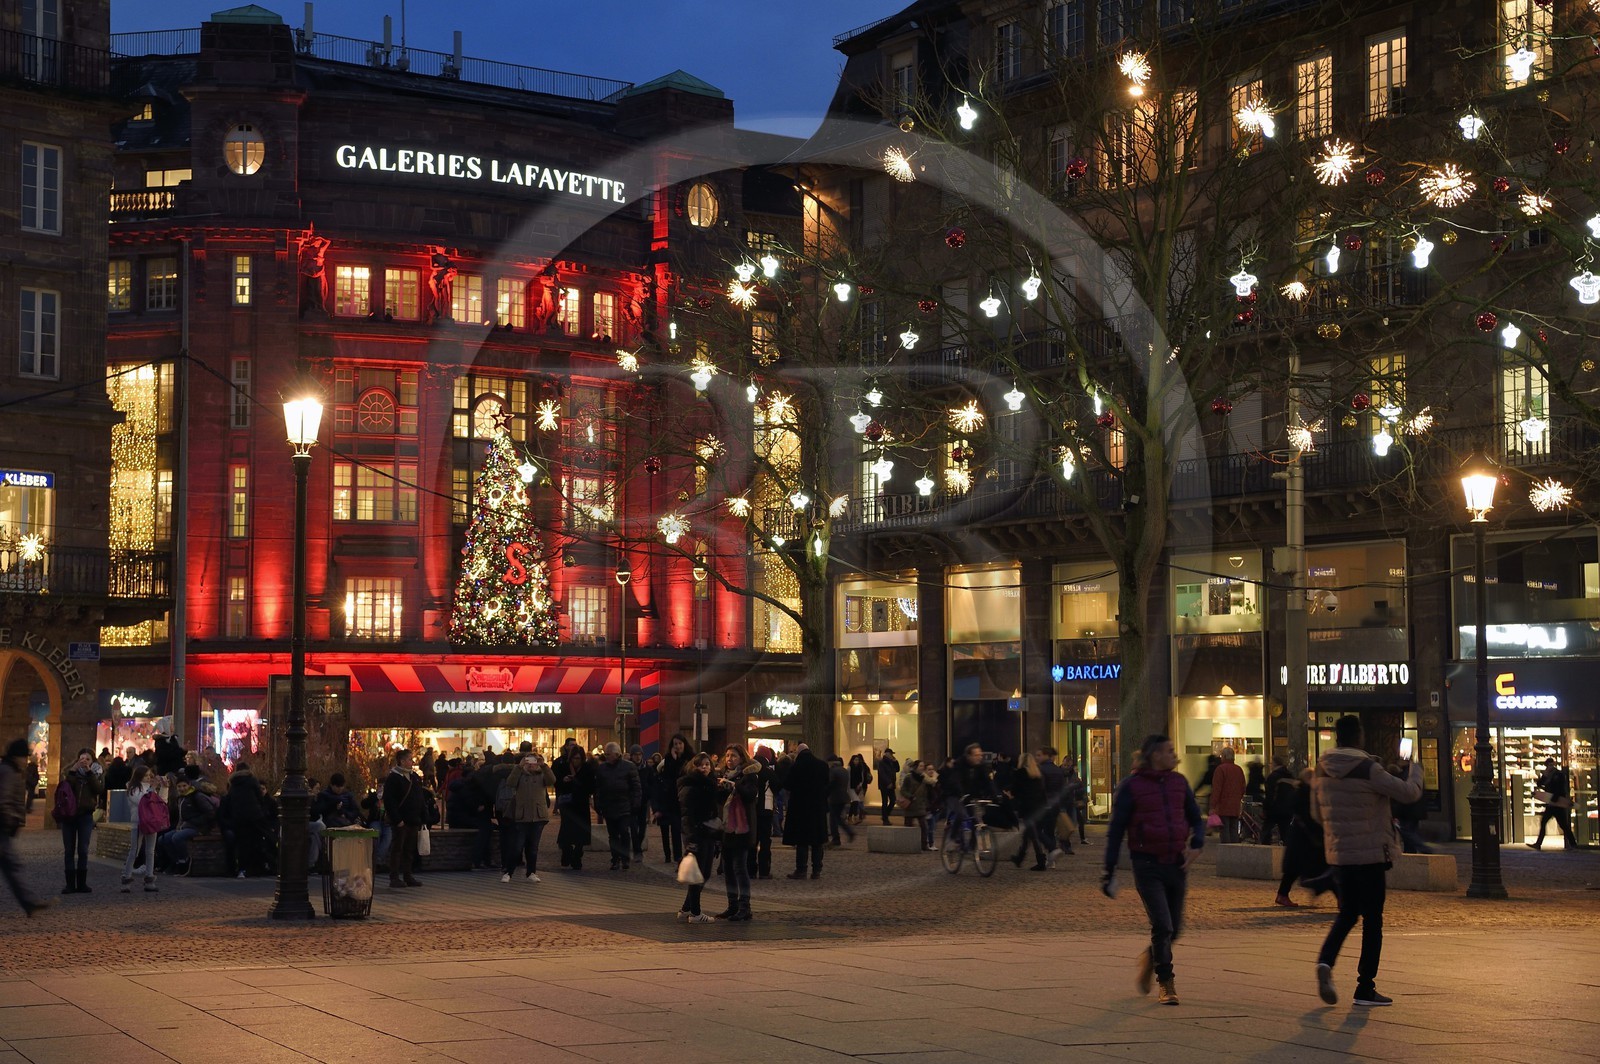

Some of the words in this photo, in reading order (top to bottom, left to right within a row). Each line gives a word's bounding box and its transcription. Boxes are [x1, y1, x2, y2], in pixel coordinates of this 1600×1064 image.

[335, 144, 482, 181] GALERIES
[491, 159, 626, 204] LAFAYETTE
[21, 630, 86, 700] KLEBER
[1066, 664, 1122, 681] BARCLAY
[1329, 663, 1410, 686] D'ALBERTO
[318, 703, 343, 714] Noël
[433, 700, 495, 714] GALERIES
[496, 701, 562, 714] LAFAYETTE
[1495, 695, 1558, 710] COURIR
[1325, 716, 1334, 724] 10
